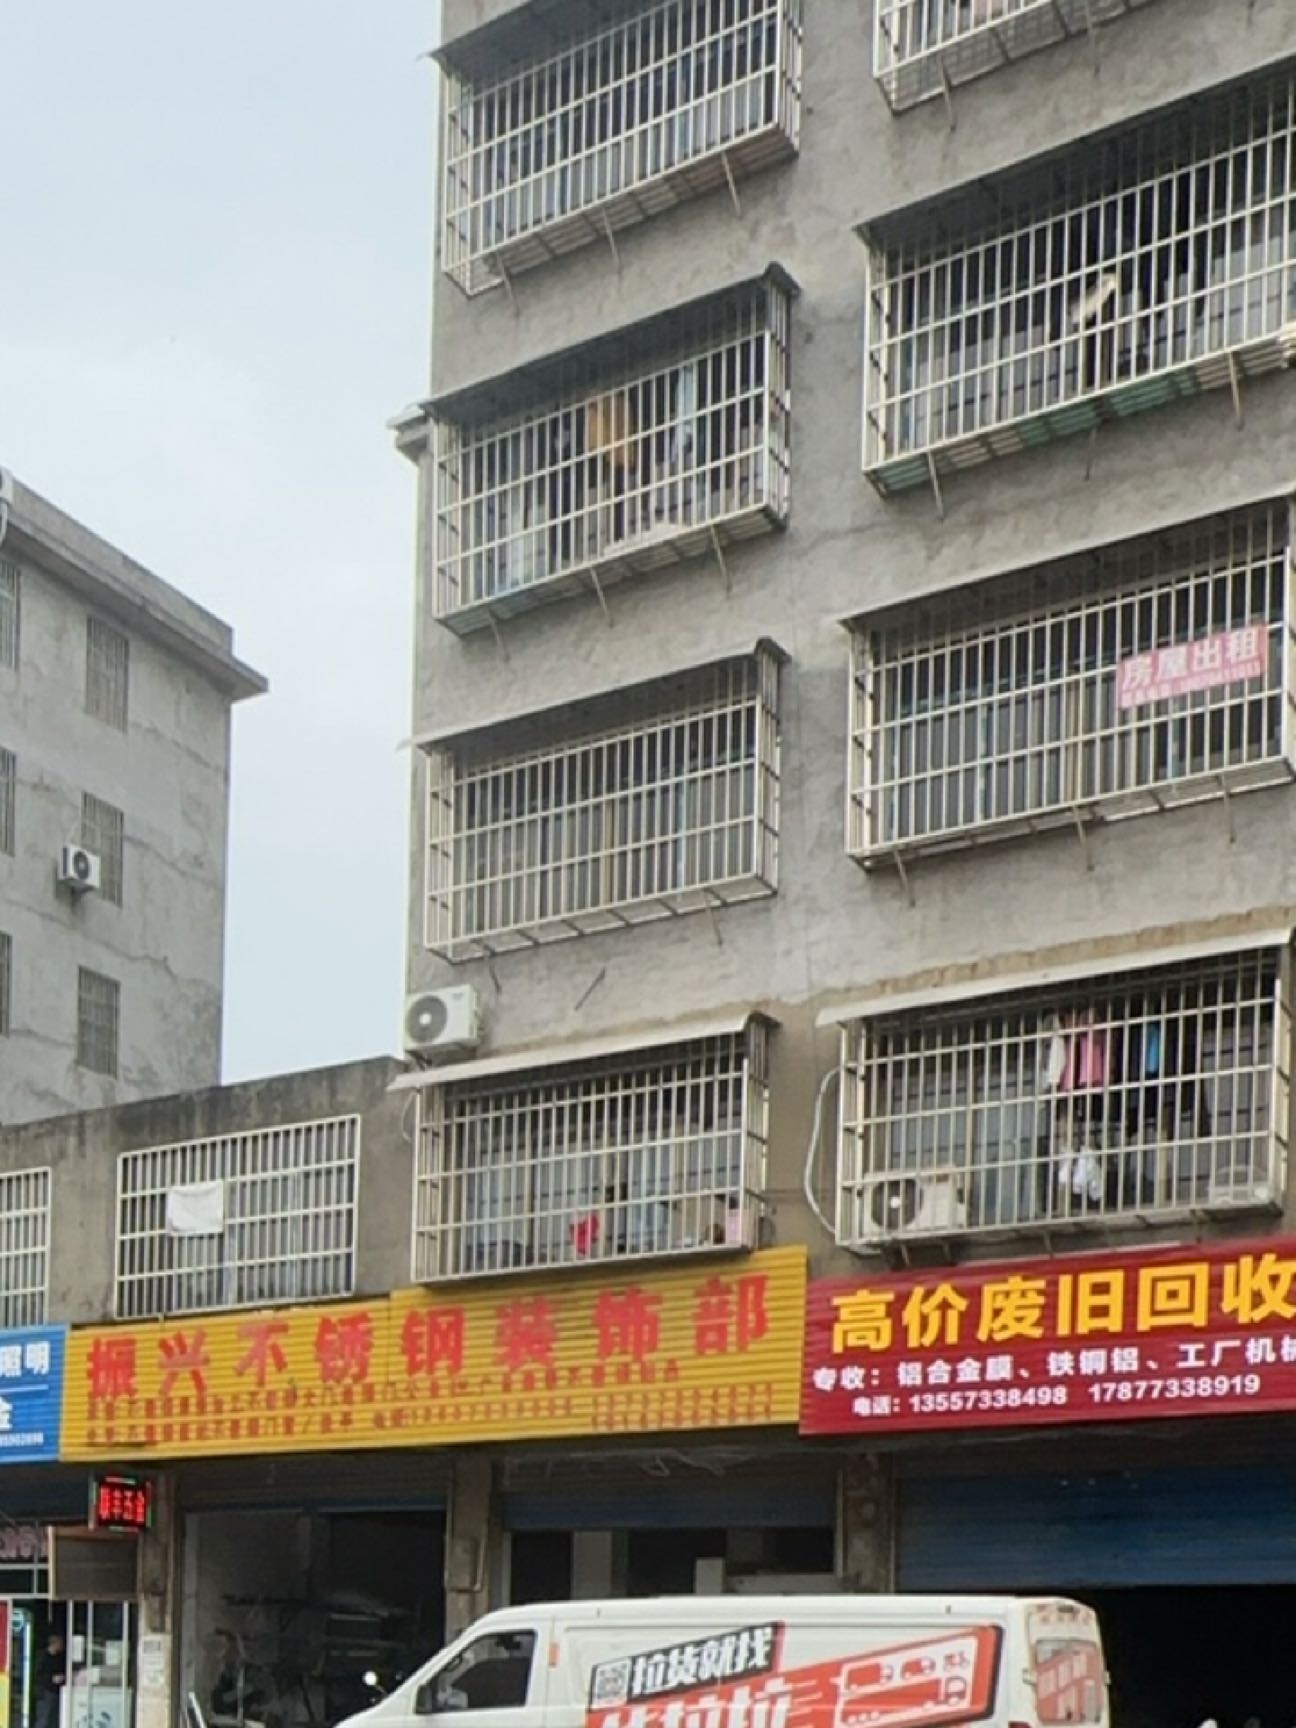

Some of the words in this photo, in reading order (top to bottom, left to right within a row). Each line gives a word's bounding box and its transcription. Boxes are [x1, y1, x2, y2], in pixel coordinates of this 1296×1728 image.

[87, 1273, 768, 1397] 振兴不锈钢装饰部
[831, 1253, 1296, 1354] 高价废旧回收
[1089, 1375, 1260, 1402] 17877338919
[632, 1627, 773, 1697] 拉货就找
